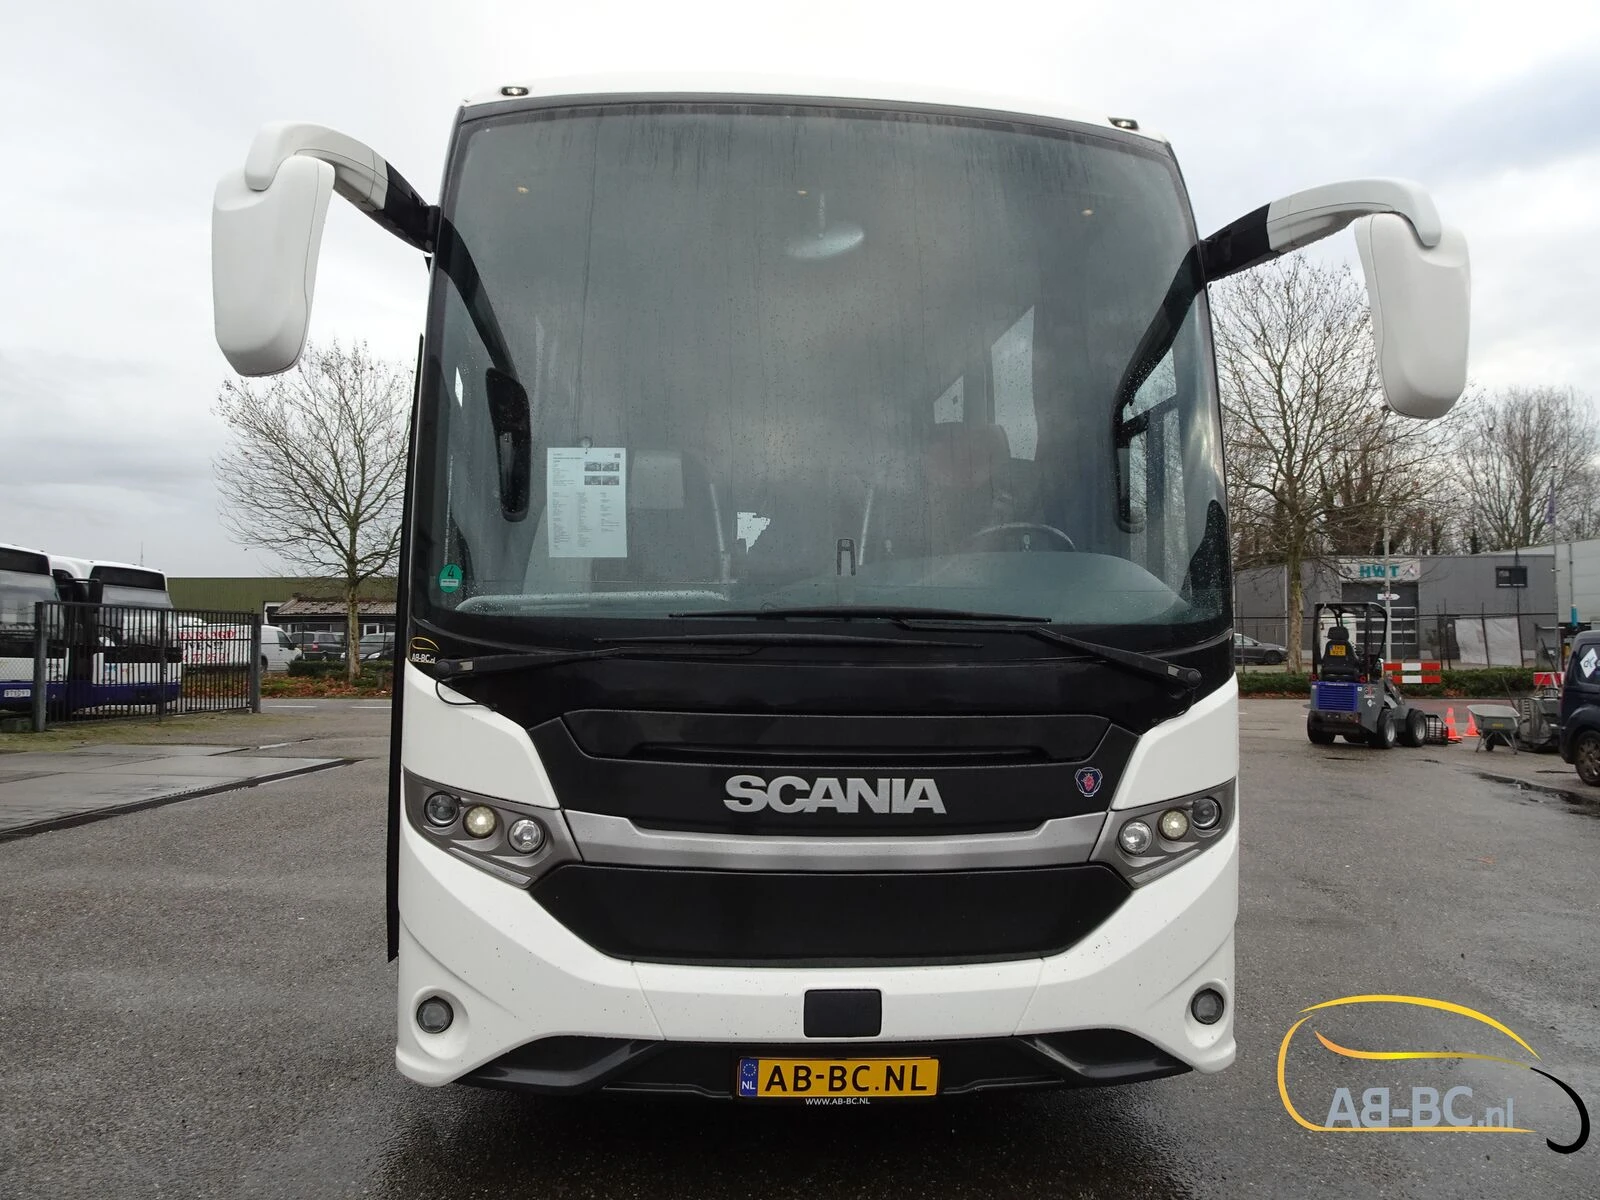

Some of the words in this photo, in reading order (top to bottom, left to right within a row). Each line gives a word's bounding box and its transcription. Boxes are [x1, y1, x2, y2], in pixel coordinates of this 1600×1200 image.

[1360, 564, 1399, 577] HWT
[723, 774, 947, 814] SCANIA
[764, 1064, 928, 1092] AB-BC.NL
[741, 1081, 756, 1091] NL
[805, 1097, 871, 1106] WWW.AB-BC.NL
